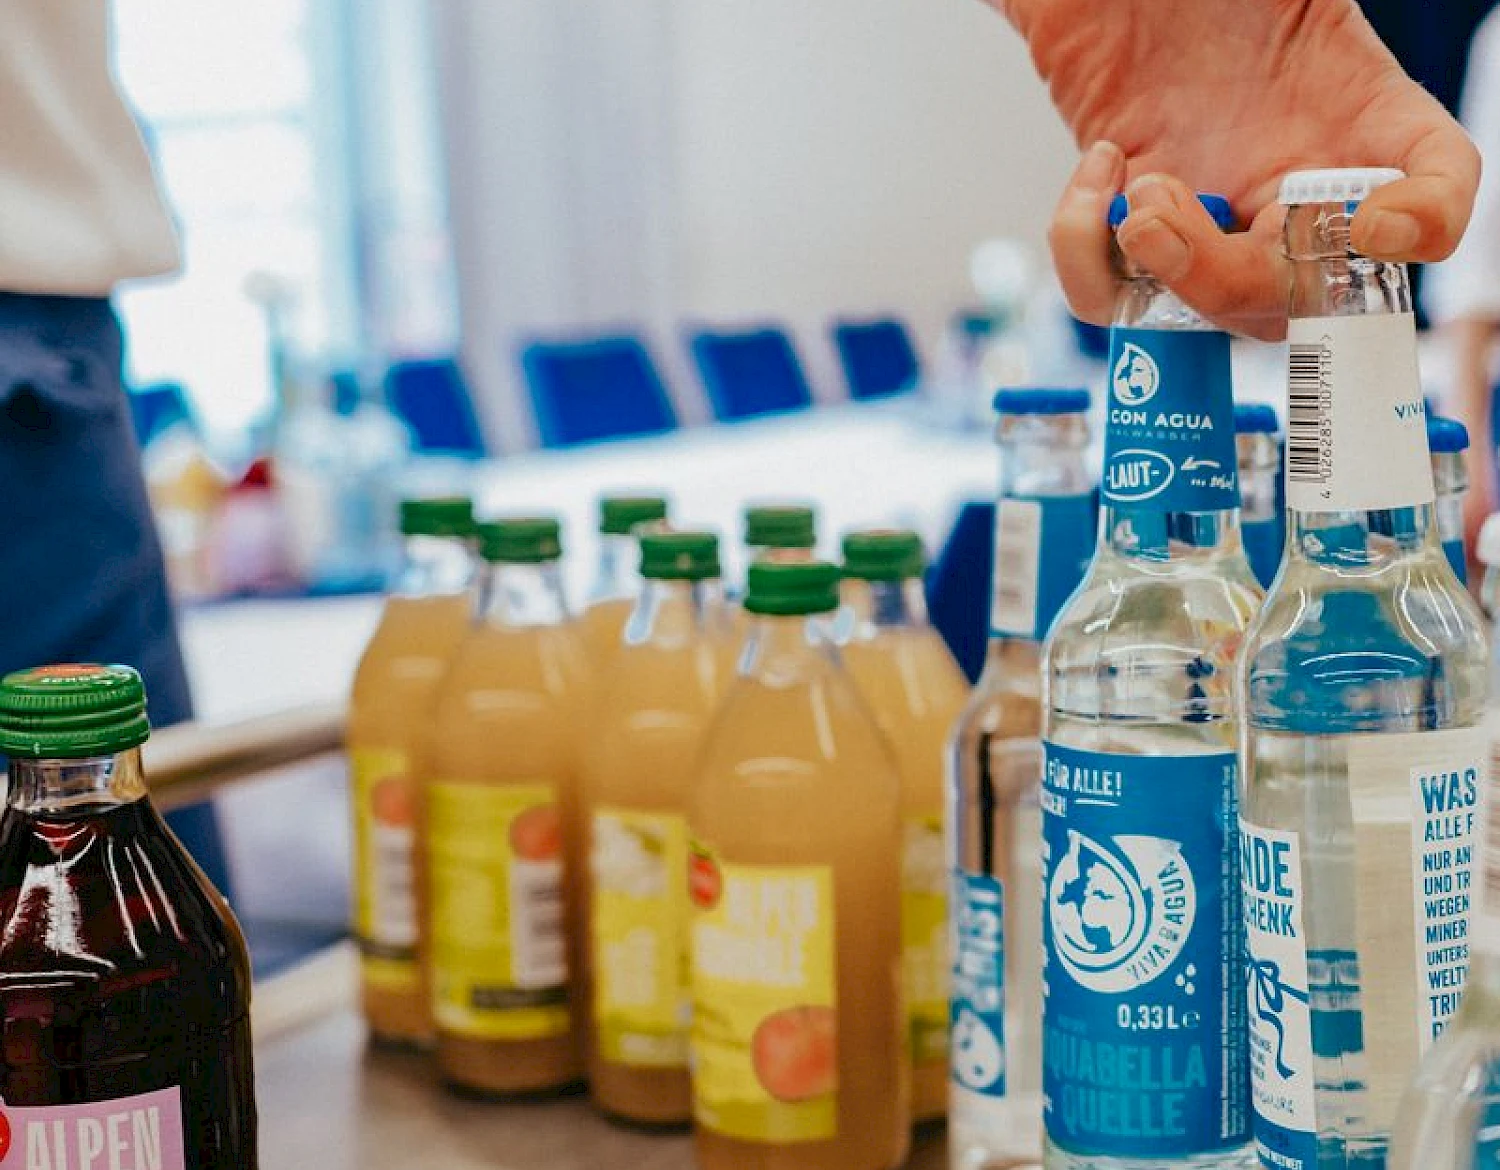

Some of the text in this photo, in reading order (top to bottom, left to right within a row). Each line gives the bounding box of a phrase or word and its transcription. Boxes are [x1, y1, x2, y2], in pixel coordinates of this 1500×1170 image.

[1320, 350, 1333, 409] 007110
[1111, 409, 1213, 430] CON AGUA
[1320, 418, 1333, 479] 026285
[1072, 766, 1123, 798] ALLE!
[1424, 814, 1462, 842] ALLE
[1423, 850, 1452, 872] NUR
[1424, 874, 1452, 896] UND
[1126, 944, 1171, 981] VIVA
[1157, 859, 1186, 926] AGUA
[1061, 1083, 1187, 1138] QUELLE
